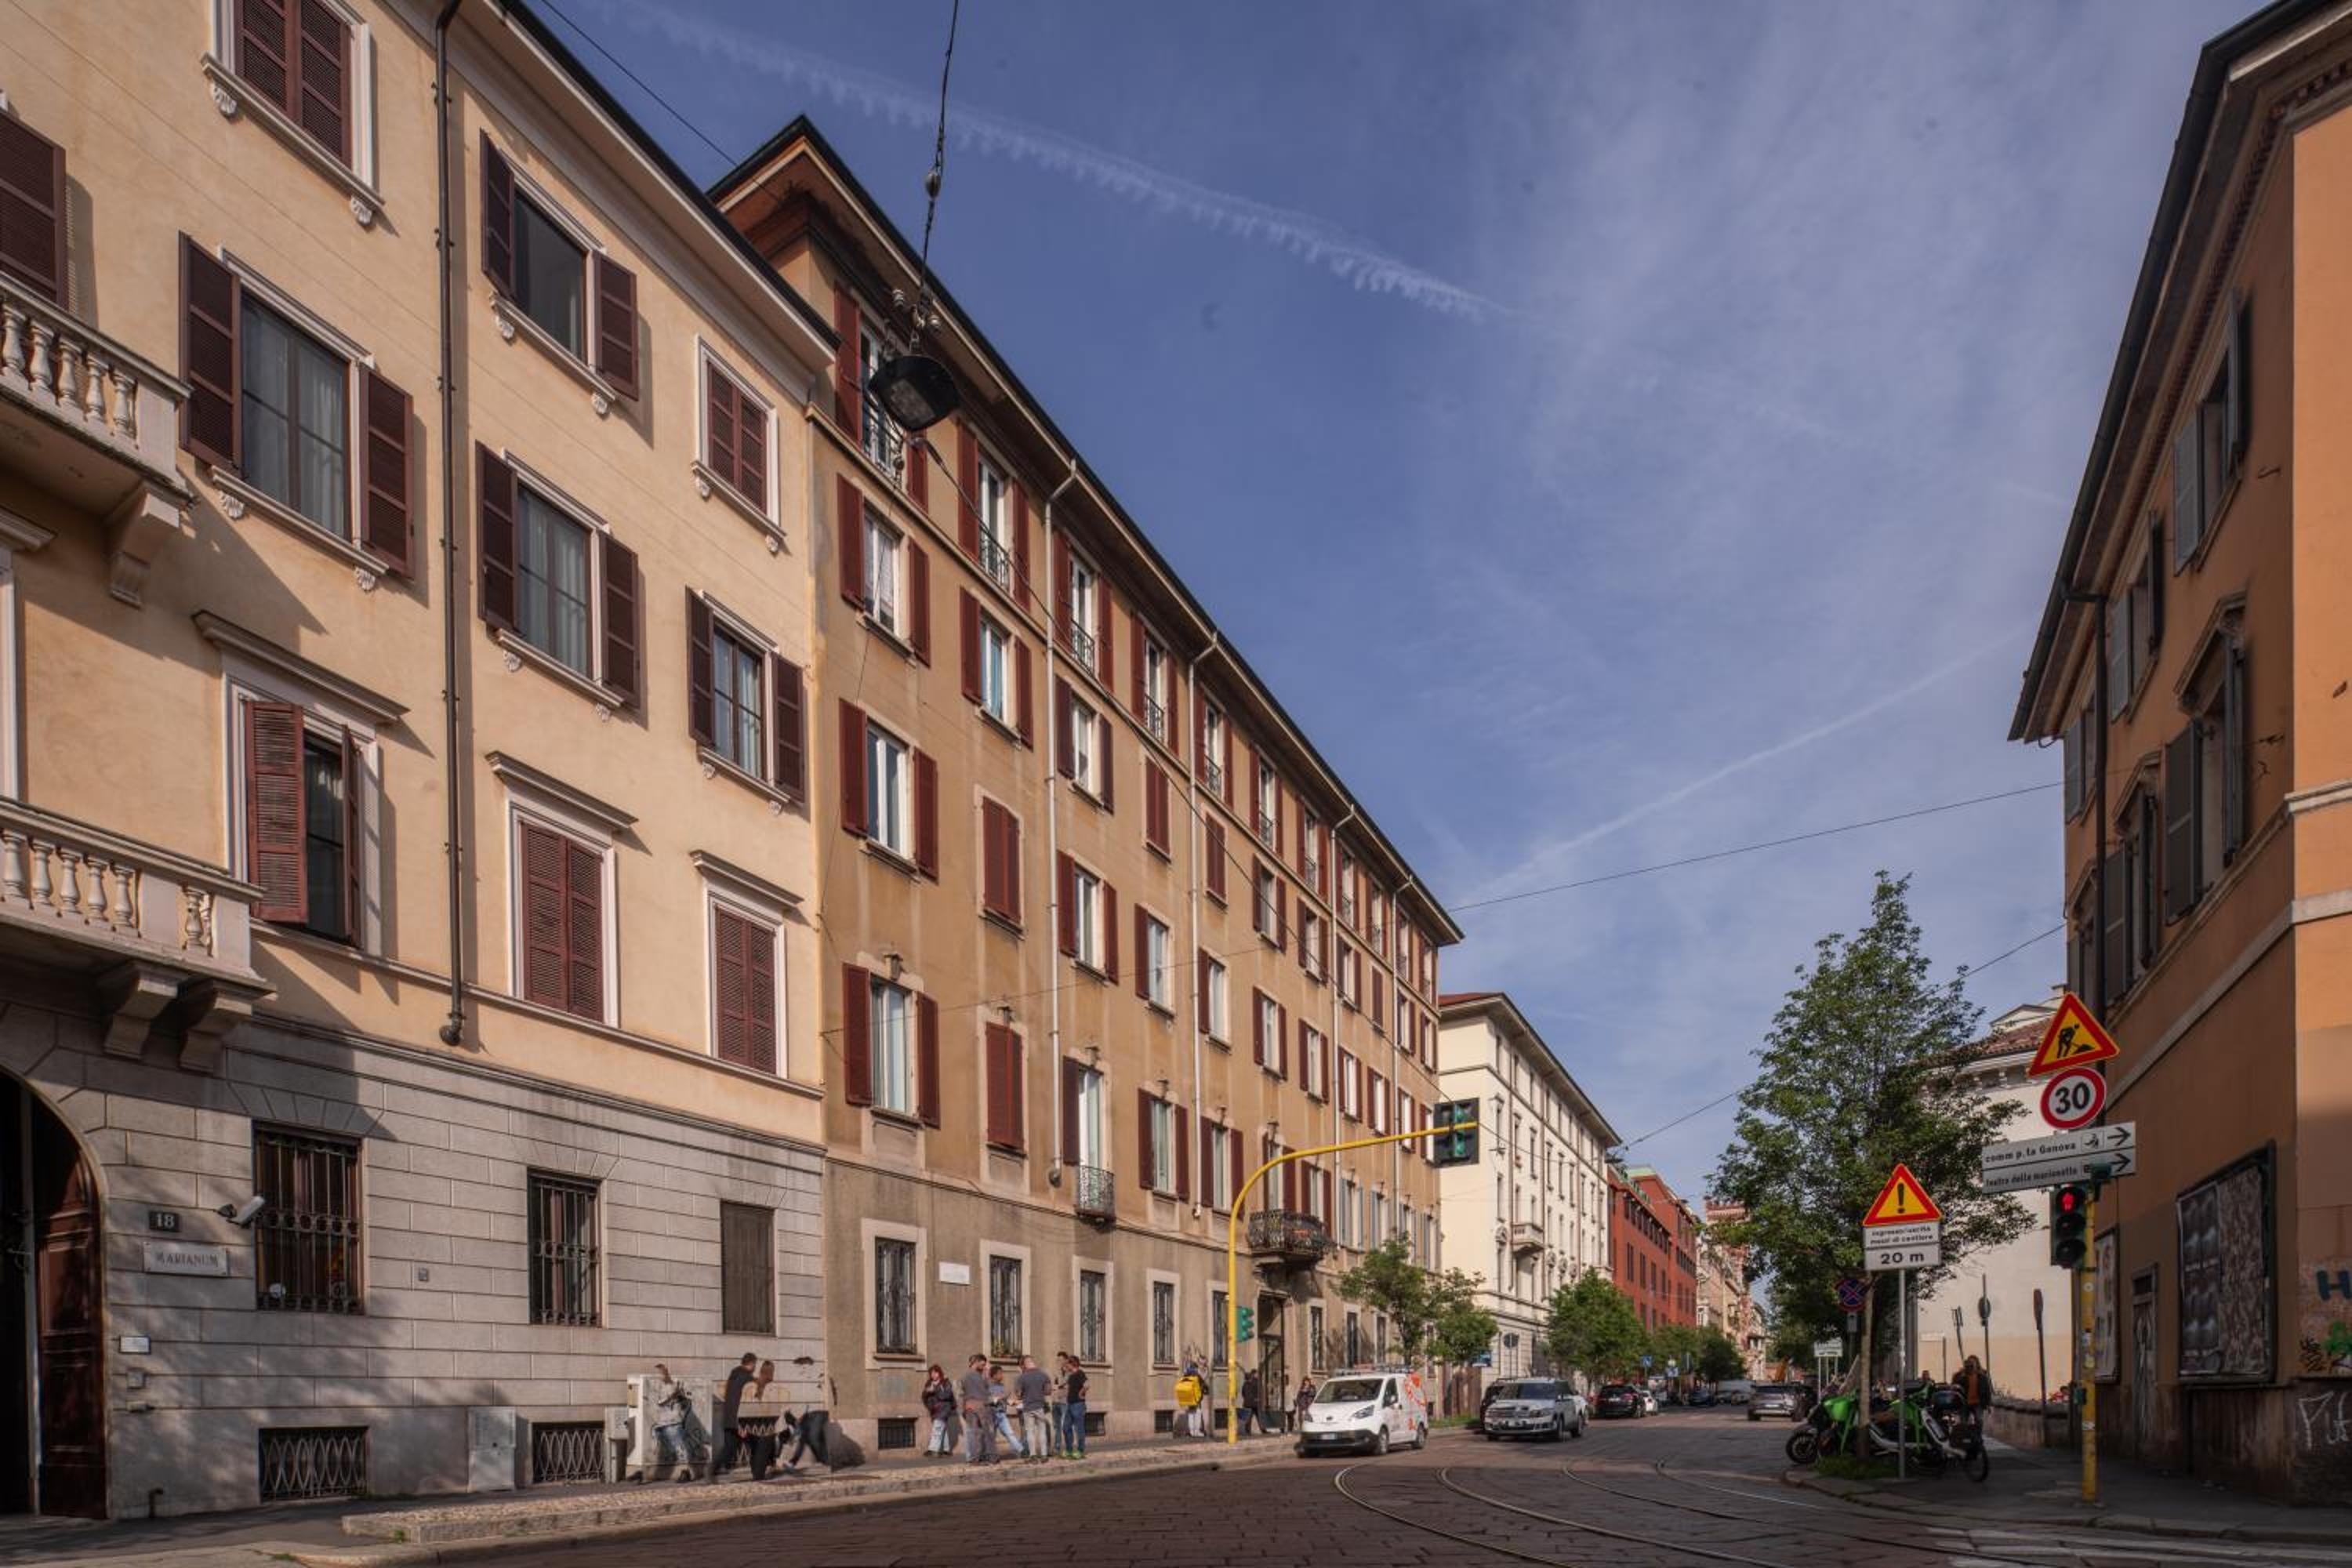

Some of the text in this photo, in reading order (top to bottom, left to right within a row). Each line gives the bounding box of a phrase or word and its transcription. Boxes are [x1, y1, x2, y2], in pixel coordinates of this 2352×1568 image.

[2055, 1082, 2091, 1114] 30
[2039, 1142, 2075, 1154] Genova
[158, 1212, 175, 1229] 18
[155, 1251, 219, 1268] MARIANUM
[1881, 1252, 1925, 1265] 20 m
